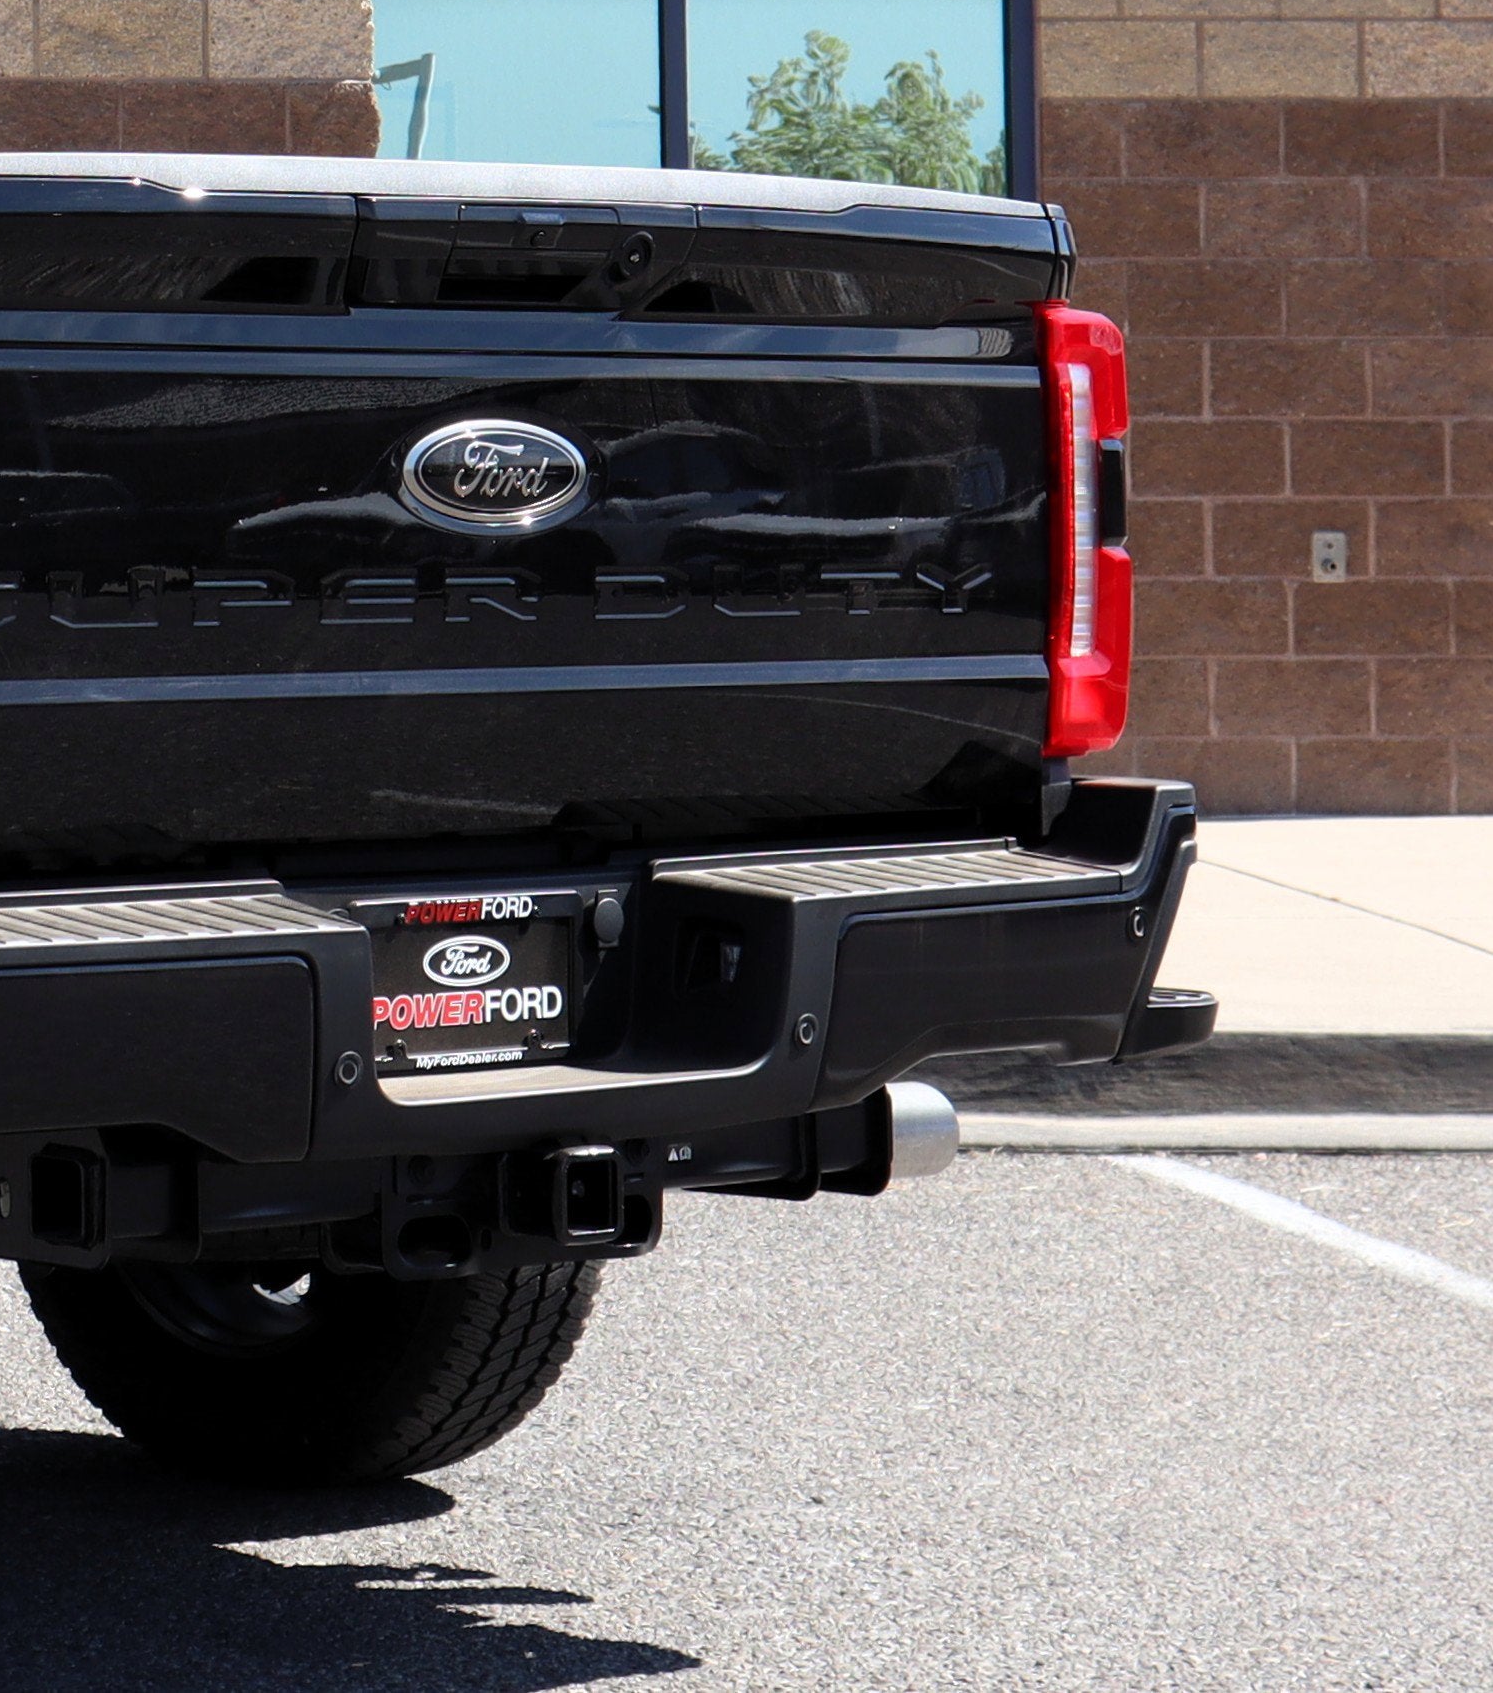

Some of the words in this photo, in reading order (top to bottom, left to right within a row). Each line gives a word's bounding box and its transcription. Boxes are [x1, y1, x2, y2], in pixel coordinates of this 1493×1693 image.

[453, 440, 550, 498] Ford
[594, 562, 994, 622] DUTY
[404, 896, 533, 924] POWERFORD
[440, 945, 492, 976] Ford
[416, 1050, 523, 1070] MyFordDealer.com
